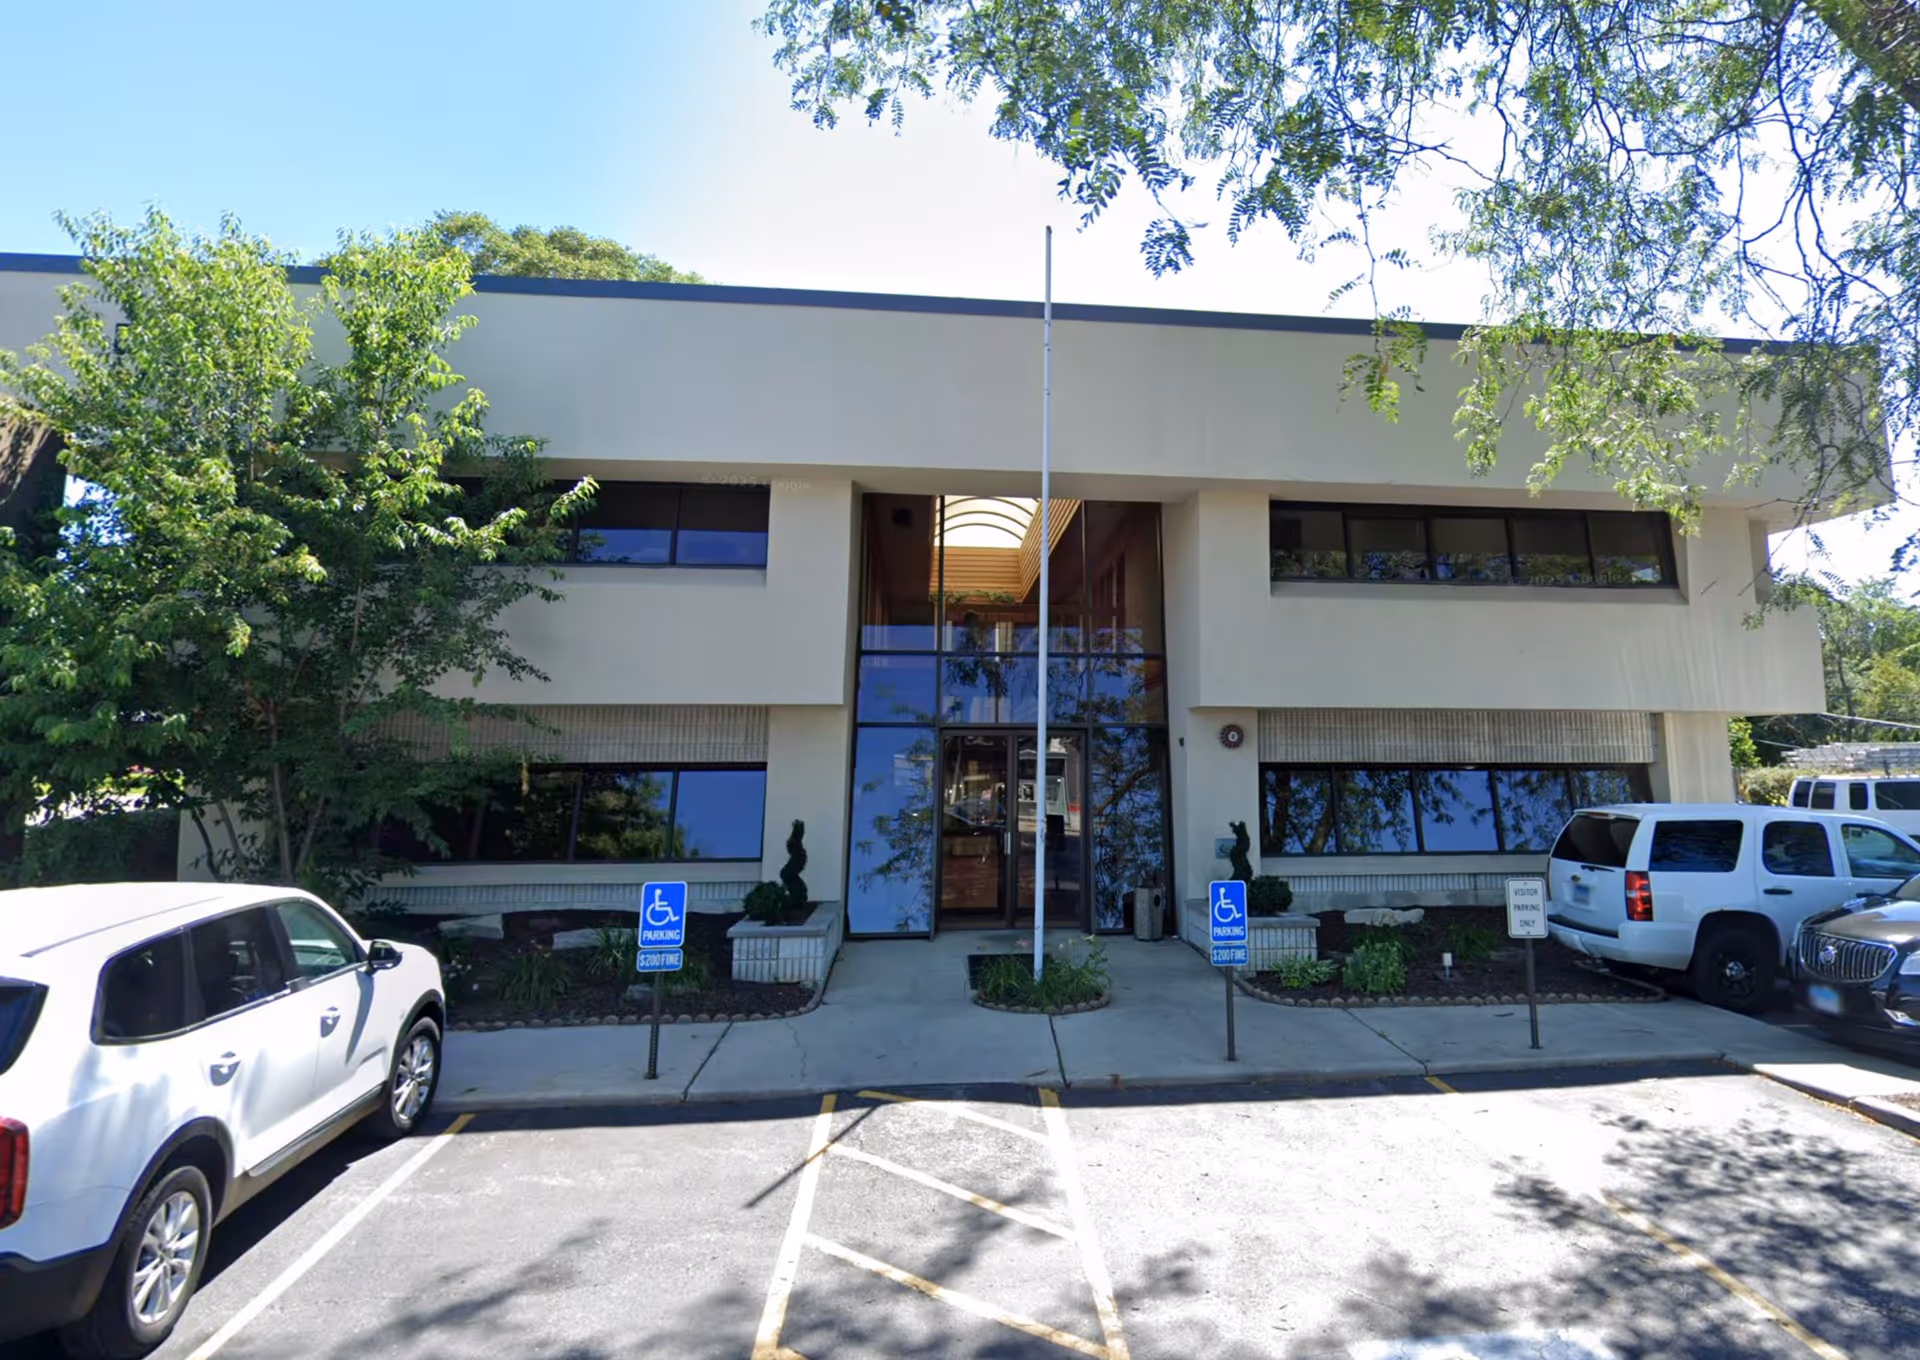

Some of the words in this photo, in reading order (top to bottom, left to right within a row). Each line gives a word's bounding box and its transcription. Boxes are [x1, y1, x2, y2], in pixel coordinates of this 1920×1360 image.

[1513, 888, 1538, 896] VISITOR
[1513, 904, 1541, 912] PARKING
[1519, 919, 1537, 928] ONLY
[642, 929, 681, 941] PARKING
[1213, 926, 1245, 937] PARKING
[639, 953, 660, 967] $200
[661, 952, 681, 965] FINE
[1212, 948, 1230, 961] $200
[1230, 948, 1247, 960] FINE
